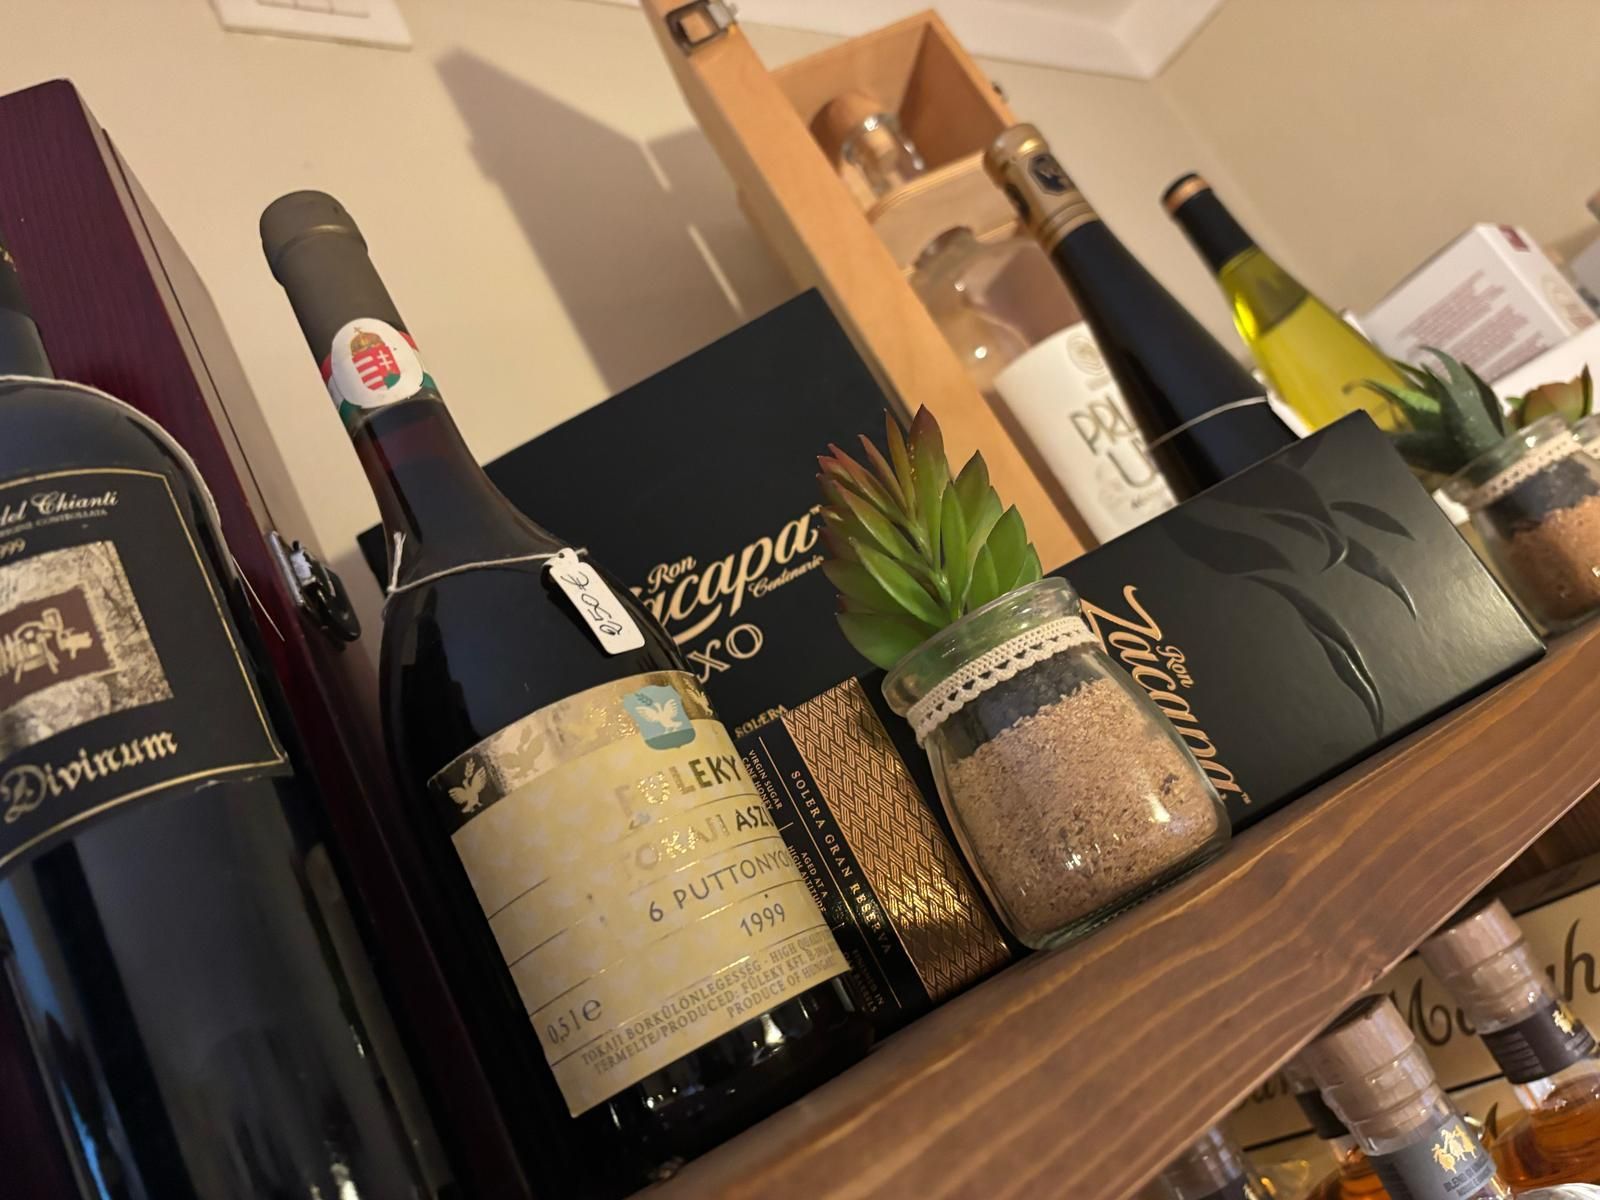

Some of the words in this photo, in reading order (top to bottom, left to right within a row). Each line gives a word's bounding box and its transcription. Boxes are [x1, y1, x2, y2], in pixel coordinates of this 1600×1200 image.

[30, 490, 119, 514] Chianti
[630, 513, 819, 645] acapa
[648, 556, 697, 594] Ron
[687, 624, 764, 684] XO
[1156, 645, 1195, 688] Ron
[1080, 585, 1242, 792] Zacapa
[735, 704, 787, 738] SOLERA
[0, 731, 178, 824] Divinum
[748, 749, 768, 780] VIRGIN
[764, 780, 784, 811] SUGAR
[787, 845, 803, 870] HIGH
[791, 770, 826, 830] SOLERA
[824, 834, 854, 879] GRAN
[849, 882, 891, 954] RESERVA
[800, 851, 818, 877] AGED
[813, 876, 826, 890] AT
[820, 890, 830, 900] A
[649, 901, 664, 922] 6
[740, 903, 785, 937] 1999
[581, 1033, 624, 1066] TOKAJI
[768, 942, 798, 963] HIGH
[726, 980, 786, 1018] PRODUCE
[786, 973, 802, 987] OF
